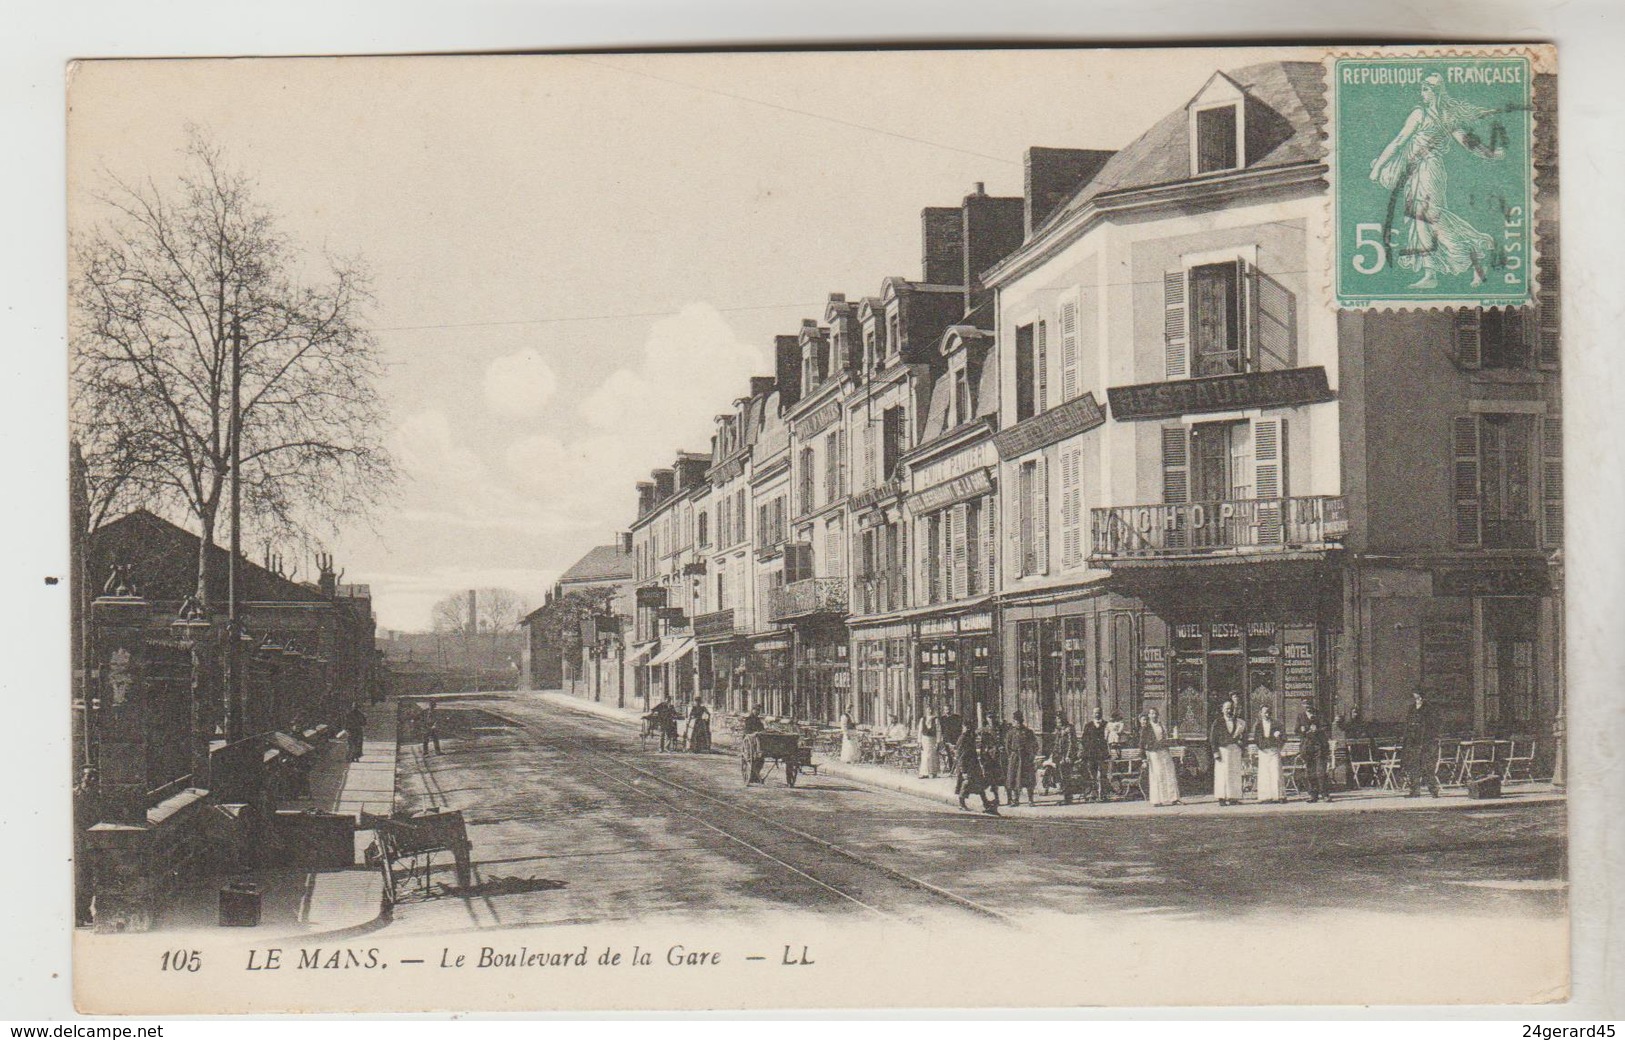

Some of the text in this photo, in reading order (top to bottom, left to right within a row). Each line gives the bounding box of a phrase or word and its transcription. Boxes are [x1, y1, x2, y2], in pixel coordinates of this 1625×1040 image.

[1343, 67, 1521, 87] REPUBLIQUE FRANÇAISE
[1504, 205, 1522, 285] POSTES
[1283, 643, 1312, 659] HÔTEL
[161, 949, 201, 973] 105
[246, 948, 282, 971] LE
[297, 948, 387, 970] MANS.
[440, 947, 465, 968] Le
[477, 946, 588, 968] Boulevard
[598, 946, 621, 966] de
[632, 946, 651, 966] la
[667, 945, 719, 966] Gare
